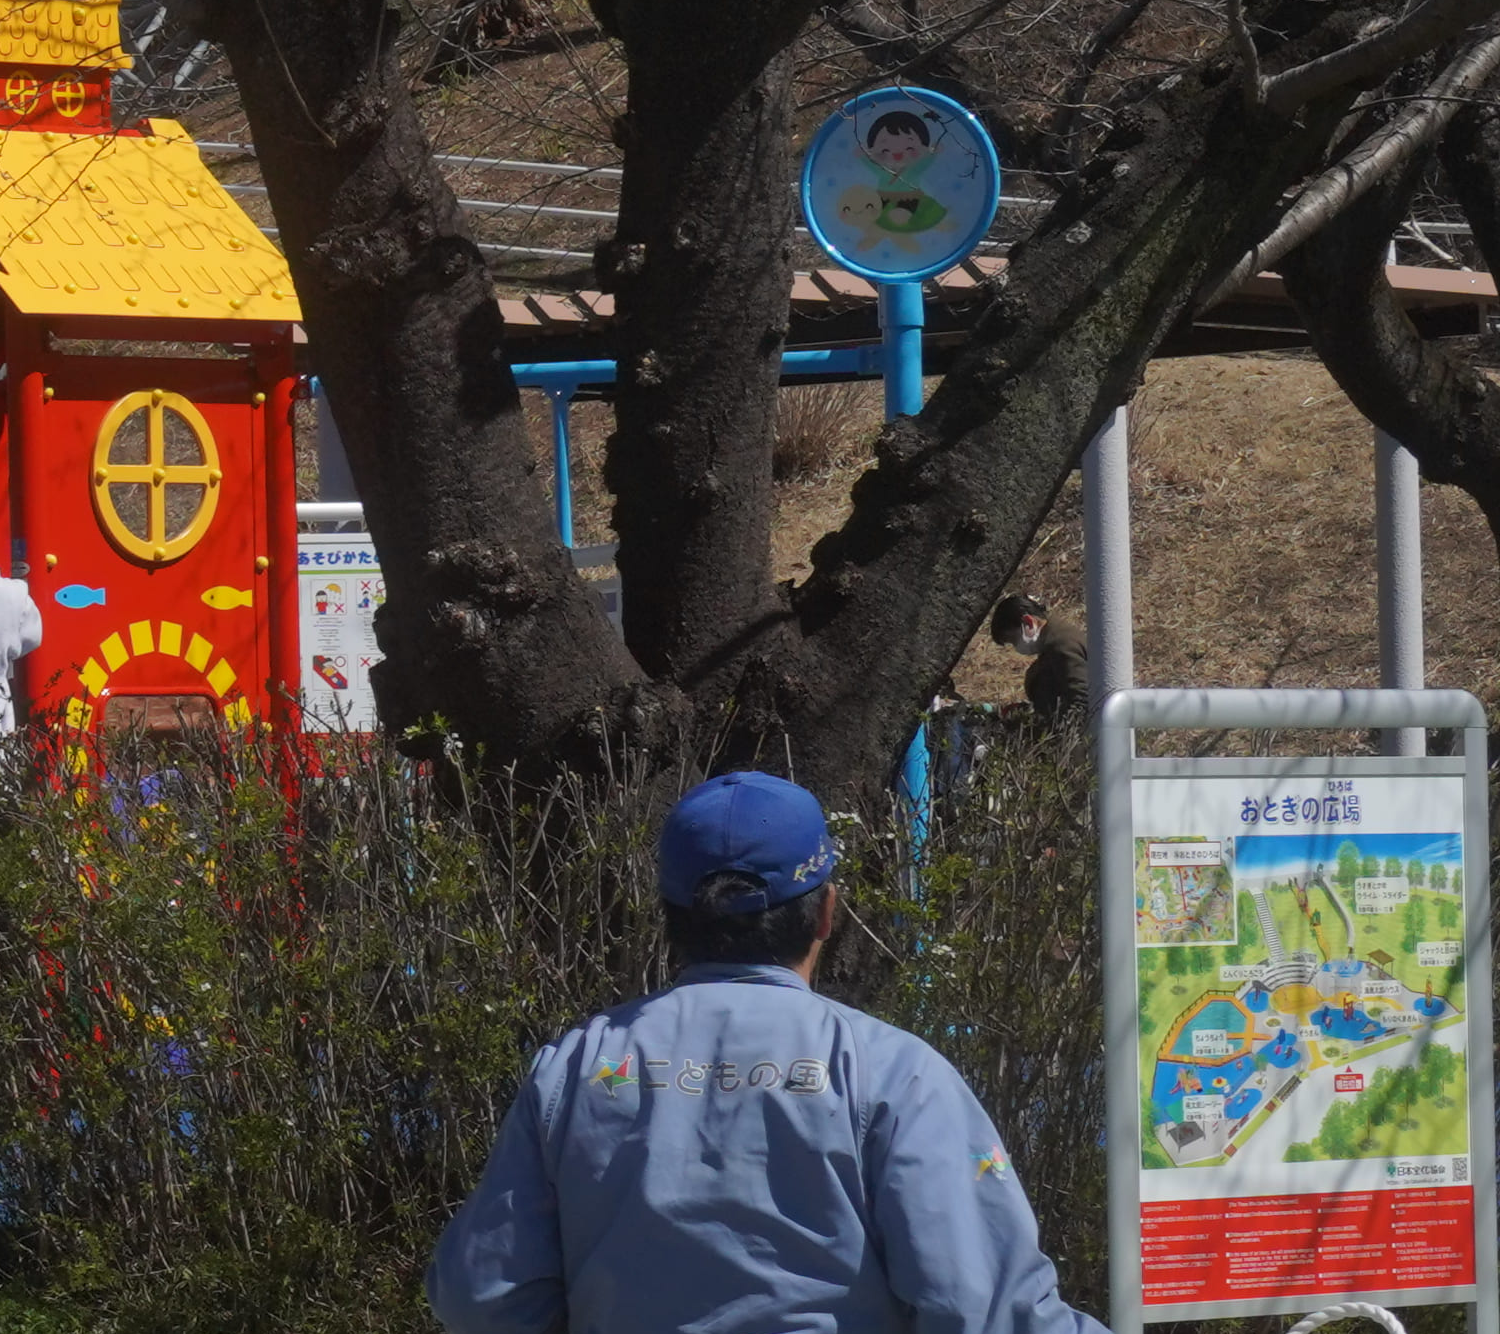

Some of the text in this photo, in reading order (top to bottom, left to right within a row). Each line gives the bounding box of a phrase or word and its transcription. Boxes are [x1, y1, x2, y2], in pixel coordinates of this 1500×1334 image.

[1327, 780, 1353, 792] ひろば
[1240, 794, 1361, 823] おとぎの広場
[645, 1058, 829, 1095] こどもの国
